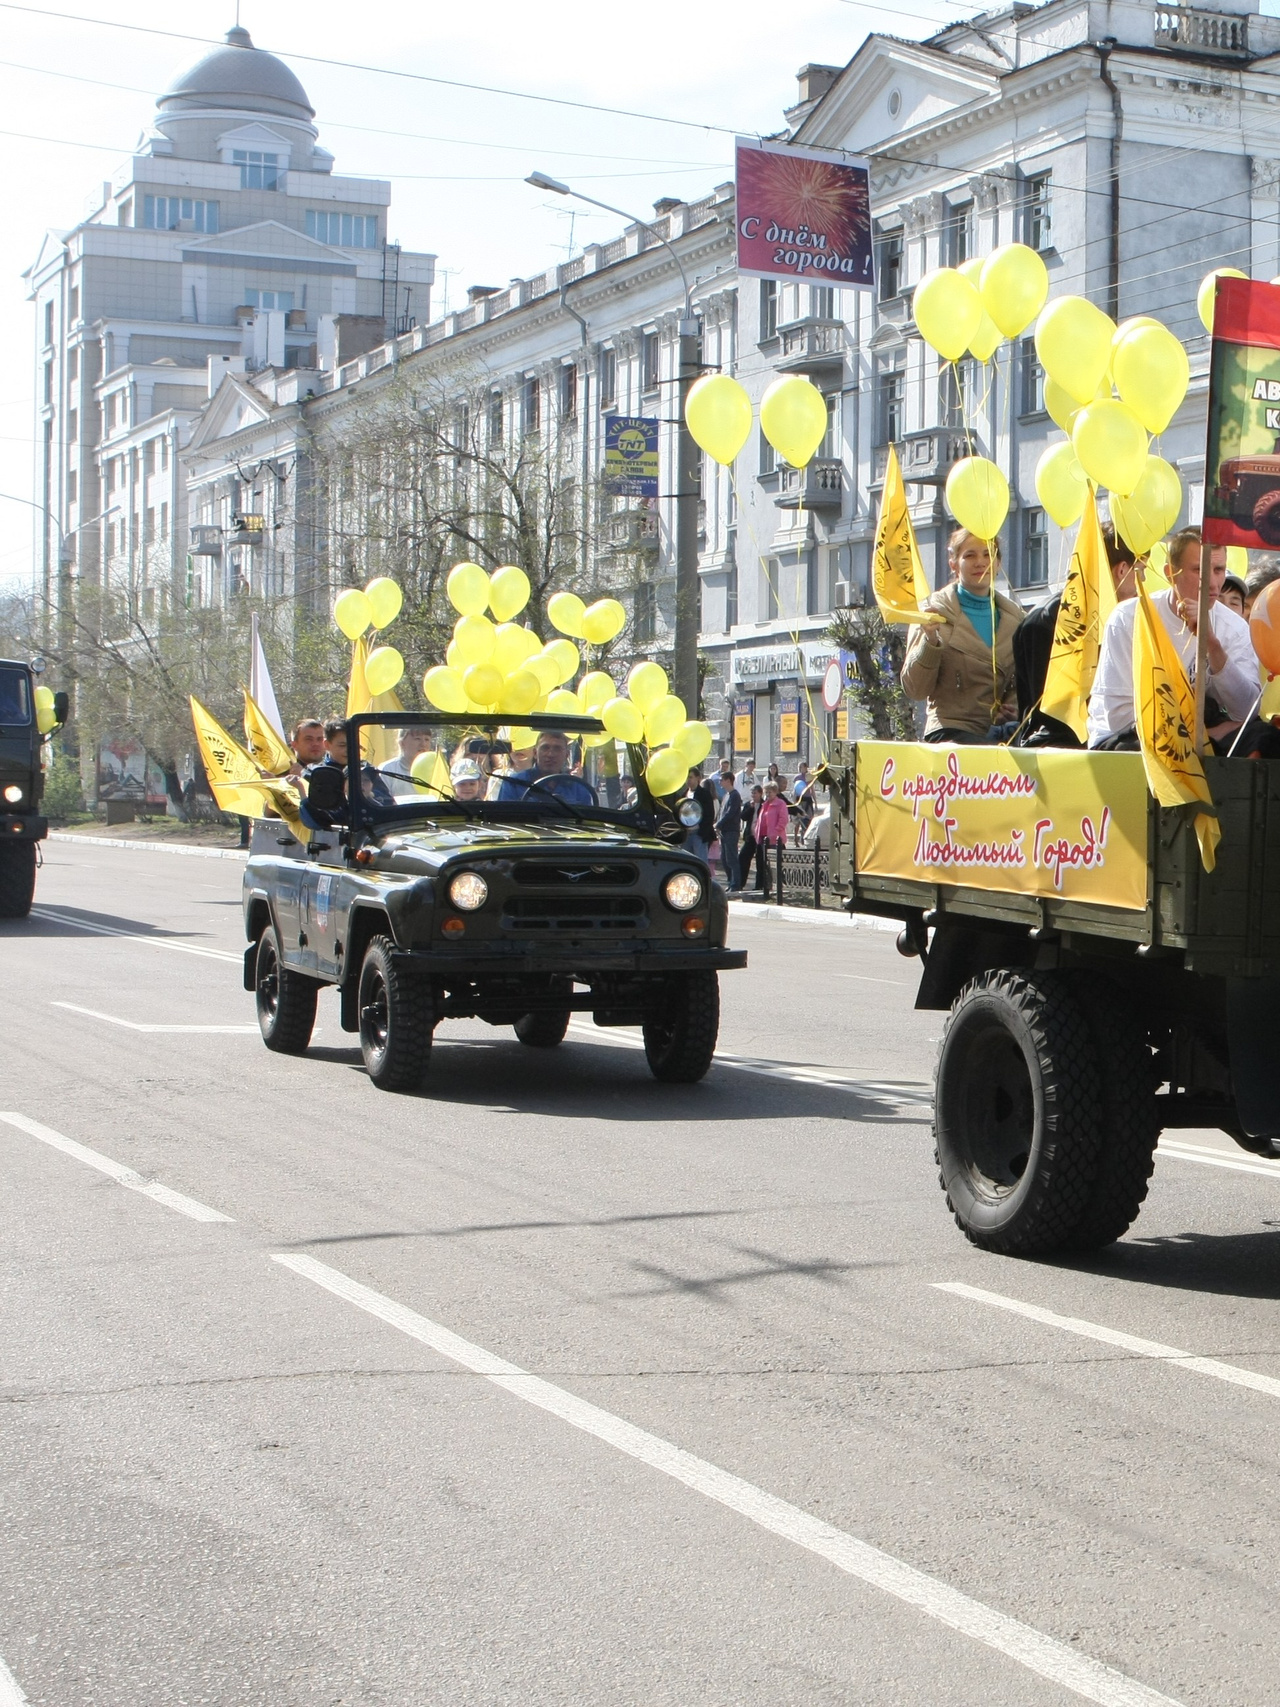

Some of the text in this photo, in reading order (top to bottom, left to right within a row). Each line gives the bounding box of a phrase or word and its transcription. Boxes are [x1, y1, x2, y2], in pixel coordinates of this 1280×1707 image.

[740, 217, 828, 250] С днём
[773, 248, 855, 273] города
[879, 751, 1037, 820] С праздником
[913, 805, 1111, 889] Любимый Город!
